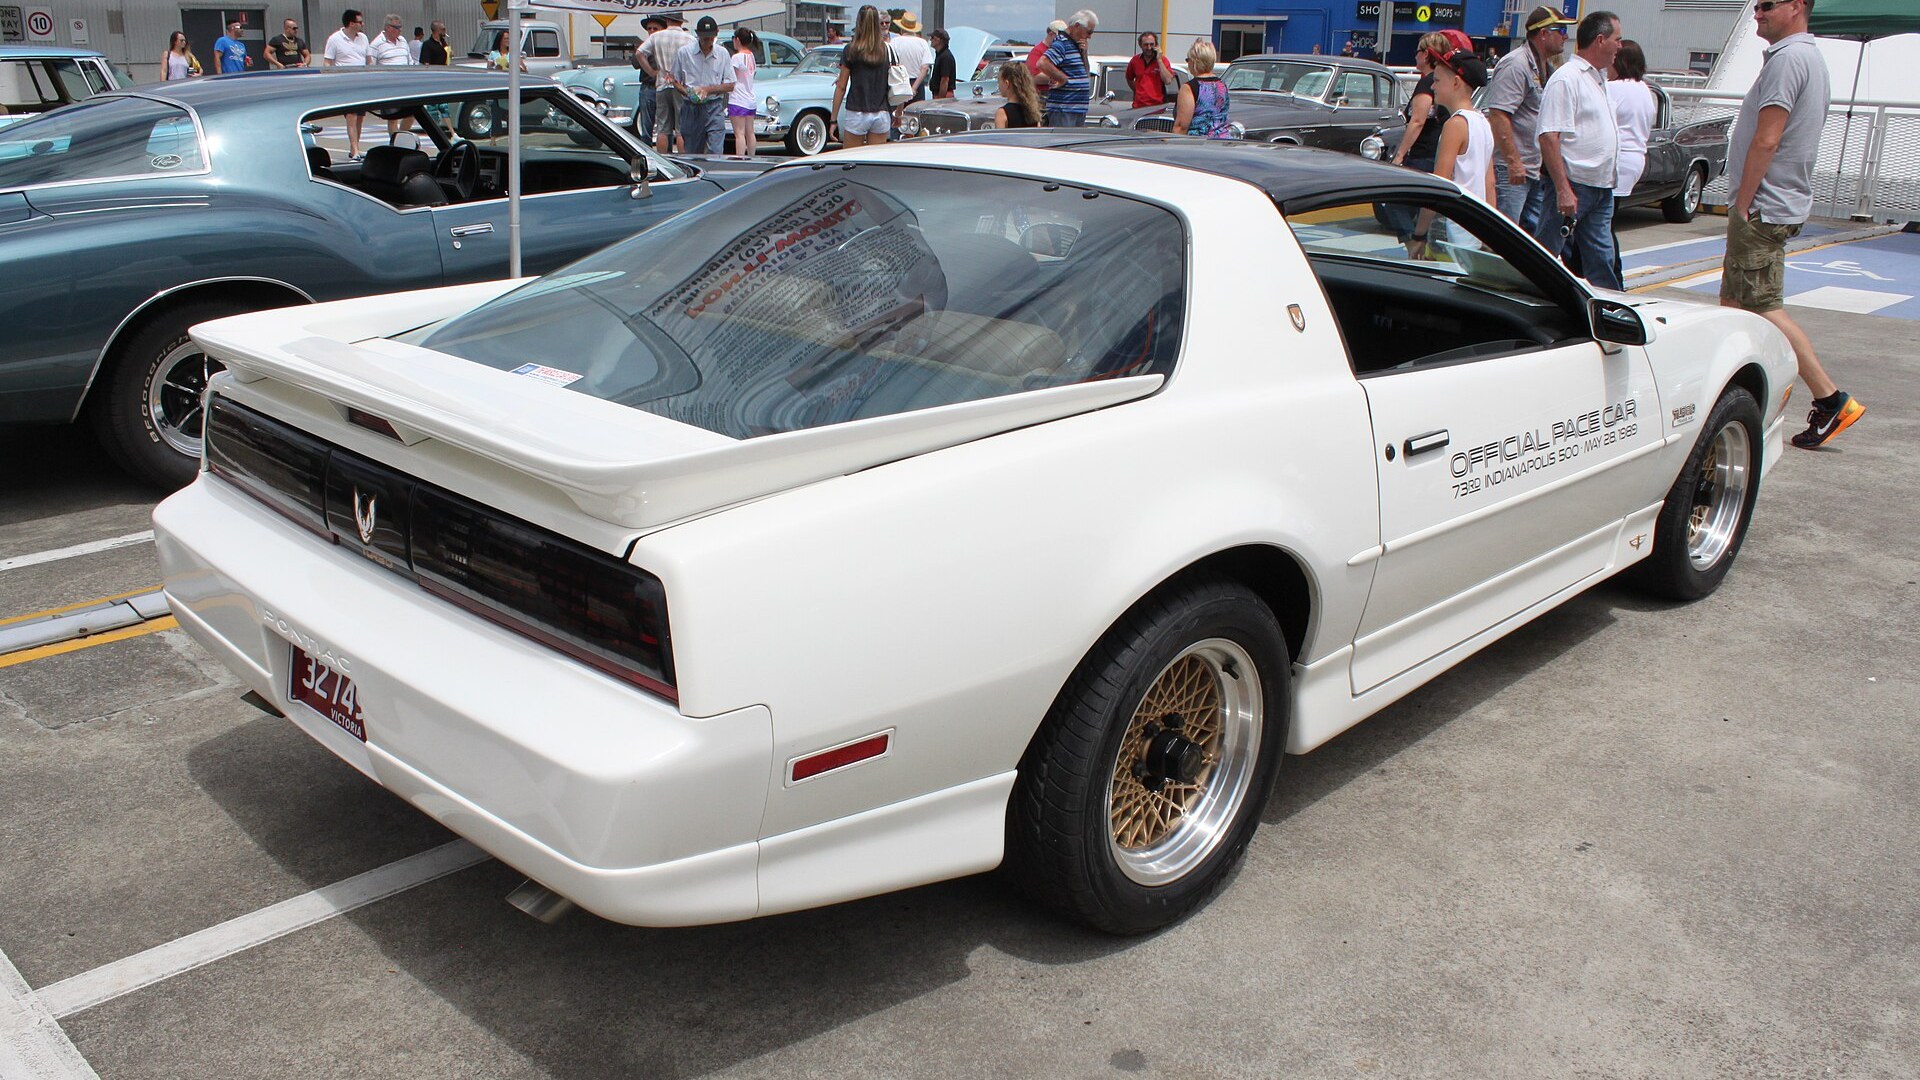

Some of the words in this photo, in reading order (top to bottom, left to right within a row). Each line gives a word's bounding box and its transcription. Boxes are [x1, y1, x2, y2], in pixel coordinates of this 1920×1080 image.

[33, 17, 47, 30] 10
[1360, 6, 1380, 15] SHO
[1435, 8, 1453, 18] SHOPS
[1450, 429, 1550, 478] OFFICIAL
[1552, 410, 1600, 445] PACE
[1602, 399, 1637, 428] CAR
[1452, 477, 1481, 499] 73RD
[1484, 451, 1556, 488] INDIANAPOLIS
[1559, 444, 1579, 462] 500
[1583, 435, 1603, 454] MAY
[1618, 423, 1638, 440] 1989
[263, 610, 351, 673] PONTIAC
[302, 652, 363, 719] 3274
[331, 708, 362, 737] VICTORIA
